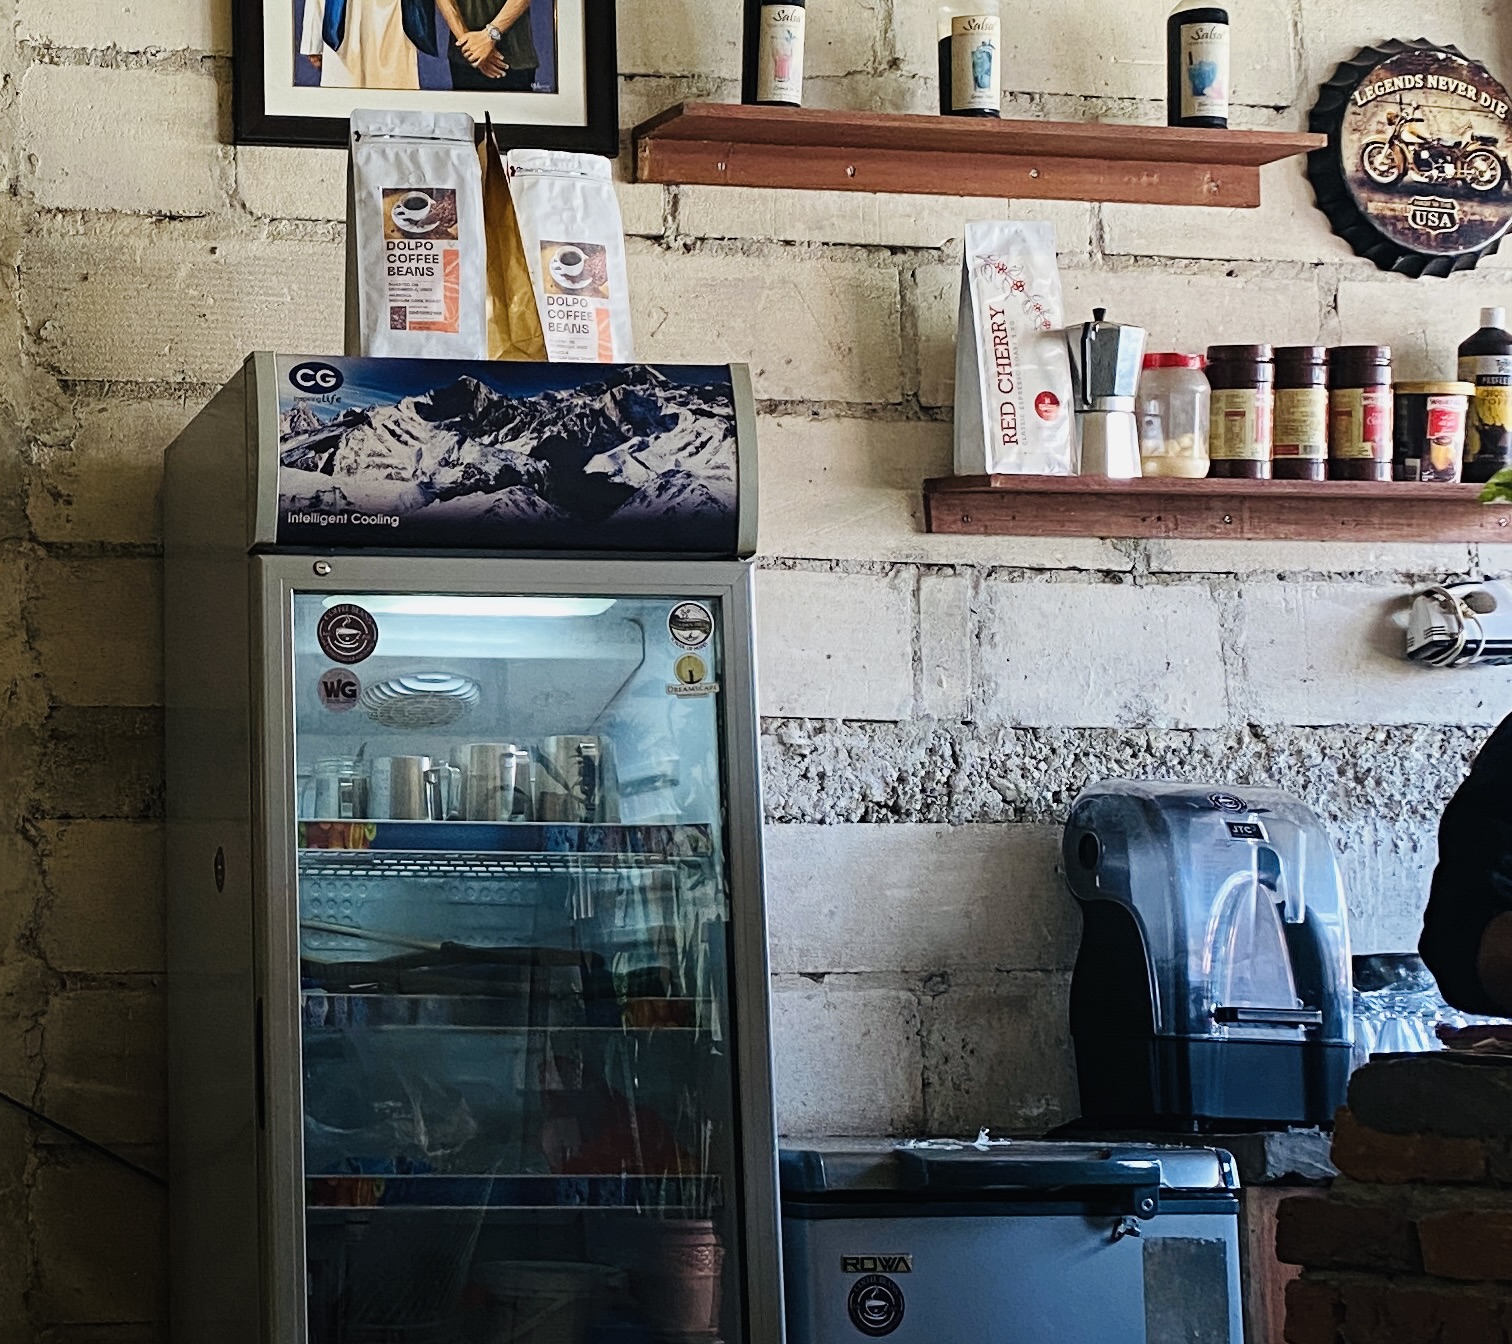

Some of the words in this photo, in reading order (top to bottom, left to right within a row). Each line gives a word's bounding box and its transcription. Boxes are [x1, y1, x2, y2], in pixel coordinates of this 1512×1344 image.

[772, 9, 801, 22] Salsa
[962, 17, 995, 31] Salsa
[1190, 25, 1222, 41] Salsa
[1351, 74, 1424, 107] LEGENDS
[1426, 74, 1478, 102] NEVER
[1479, 91, 1510, 119] DIE
[1414, 211, 1452, 228] USA
[386, 241, 434, 251] DOLPO
[386, 253, 440, 264] COFFEE
[387, 266, 435, 277] BEANS
[546, 295, 588, 308] DOLPO
[547, 309, 594, 322] COFFEE
[548, 321, 590, 334] BEANS
[989, 304, 1015, 394] CHERRY
[295, 368, 337, 387] CG
[1000, 401, 1019, 446] RED
[287, 511, 347, 526] Intelligent
[350, 512, 400, 527] Cooling
[322, 678, 357, 699] WG
[1232, 825, 1252, 834] JTC
[843, 1256, 912, 1272] ROWA
